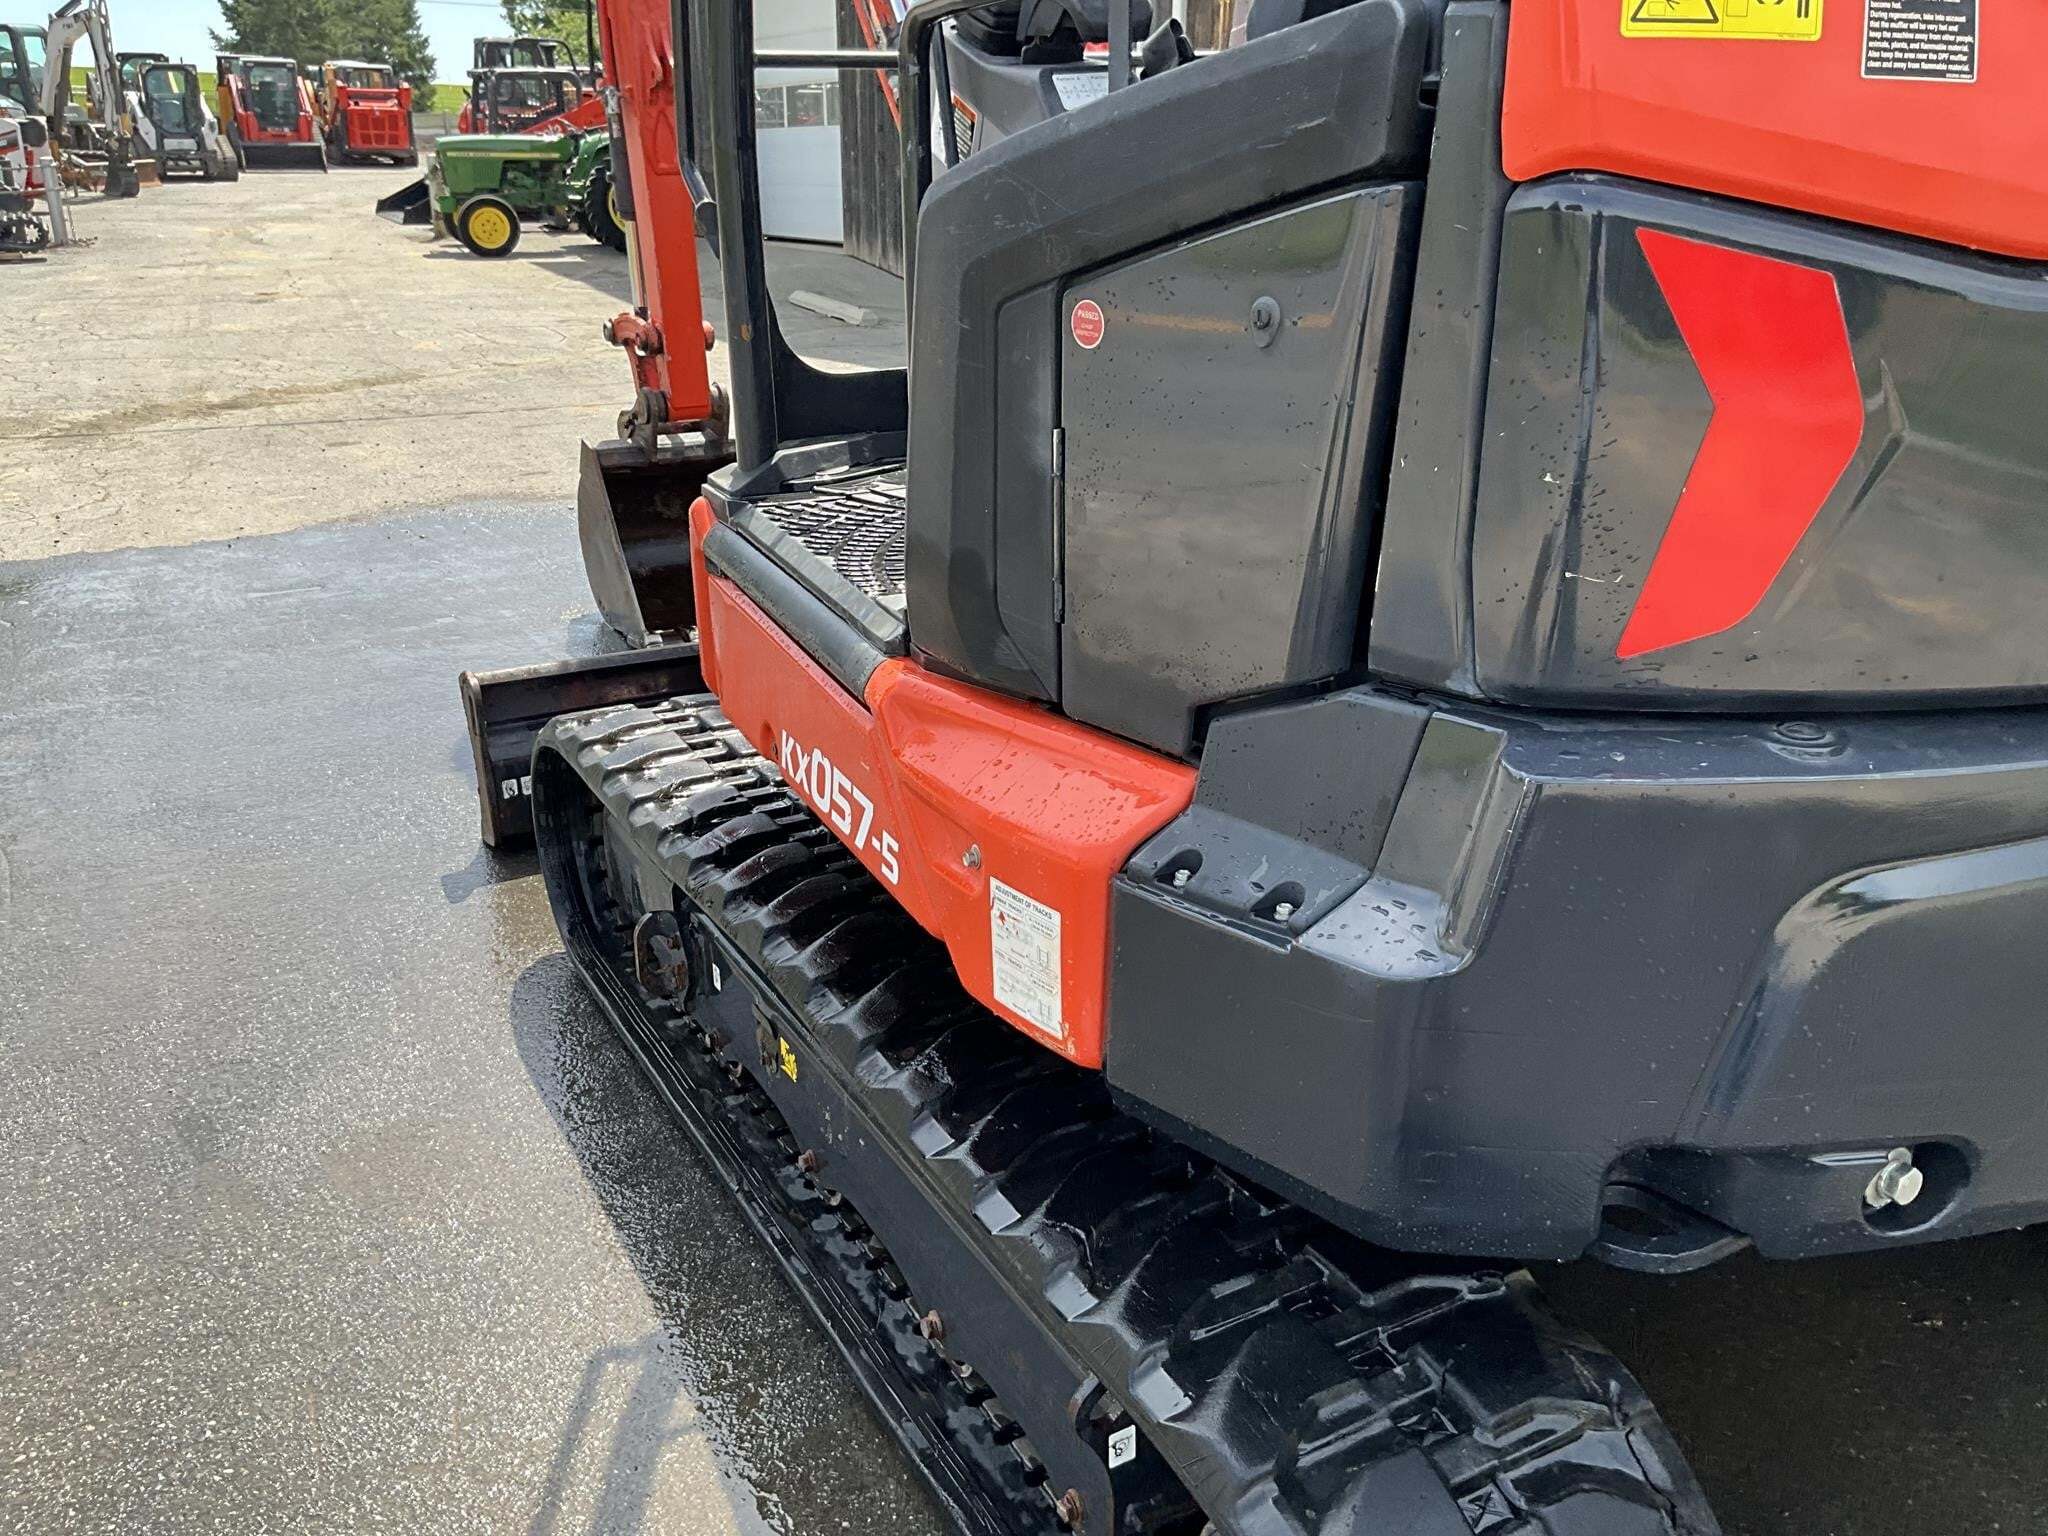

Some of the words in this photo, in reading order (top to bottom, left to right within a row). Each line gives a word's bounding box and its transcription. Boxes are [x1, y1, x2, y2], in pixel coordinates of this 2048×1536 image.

[1870, 10, 1888, 19] During
[1870, 20, 1880, 28] that
[1881, 20, 1889, 28] the
[1890, 21, 1908, 29] muffler
[1919, 22, 1926, 30] be
[1939, 23, 1948, 31] hot
[1948, 24, 1959, 32] and
[1869, 30, 1881, 39] keep
[1892, 31, 1914, 39] machine
[1915, 33, 1928, 41] away
[1868, 50, 1880, 58] Also
[1881, 51, 1893, 59] keep
[1893, 62, 1907, 70] away
[1921, 62, 1947, 70] flammable
[1032, 903, 1053, 920] TRACKS
